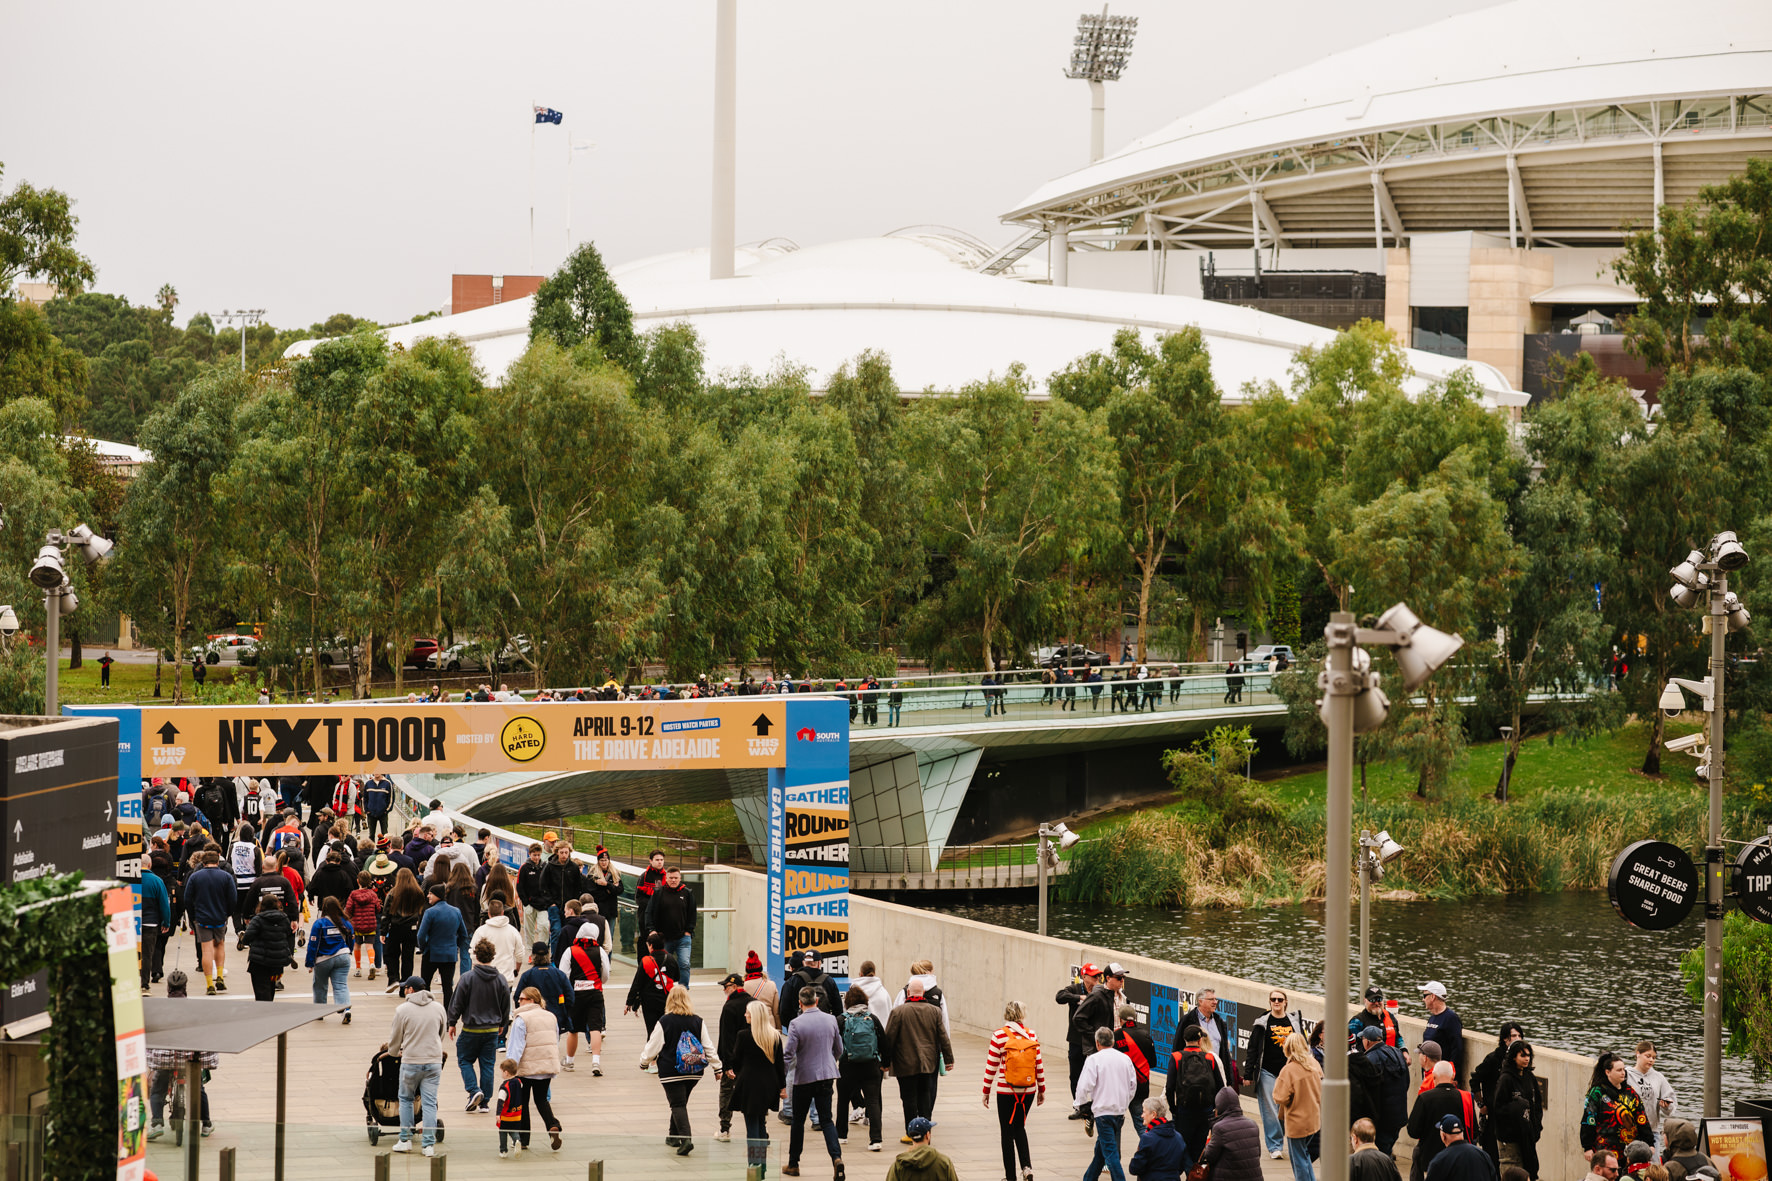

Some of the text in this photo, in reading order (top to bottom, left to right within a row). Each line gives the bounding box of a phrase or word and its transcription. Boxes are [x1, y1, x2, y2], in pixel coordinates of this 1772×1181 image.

[574, 716, 654, 737] APRIL 9-12
[663, 719, 718, 731] HOSTED WATCH PARTIES
[218, 716, 446, 764] NEXT DOOR
[456, 733, 494, 744] HOSTED BY
[512, 733, 533, 741] HARD
[746, 738, 779, 747] THIS
[816, 732, 840, 740] SOUTH
[151, 746, 186, 756] THIS
[508, 740, 540, 752] RATED
[572, 738, 720, 761] THE DRIVE ADELAIDE
[749, 747, 777, 756] WAY
[152, 756, 184, 766] WAY
[786, 786, 848, 804] GATHER
[247, 800, 258, 815] 10
[785, 812, 849, 838] ROUND
[785, 842, 849, 862] GATHER
[771, 787, 782, 956] GATHER ROUND
[1633, 862, 1688, 892] GREAT BEERS
[785, 869, 849, 897] ROUND
[1628, 874, 1683, 904] SHARED FOOD
[785, 899, 848, 917] GATHER
[785, 925, 848, 951] ROUND
